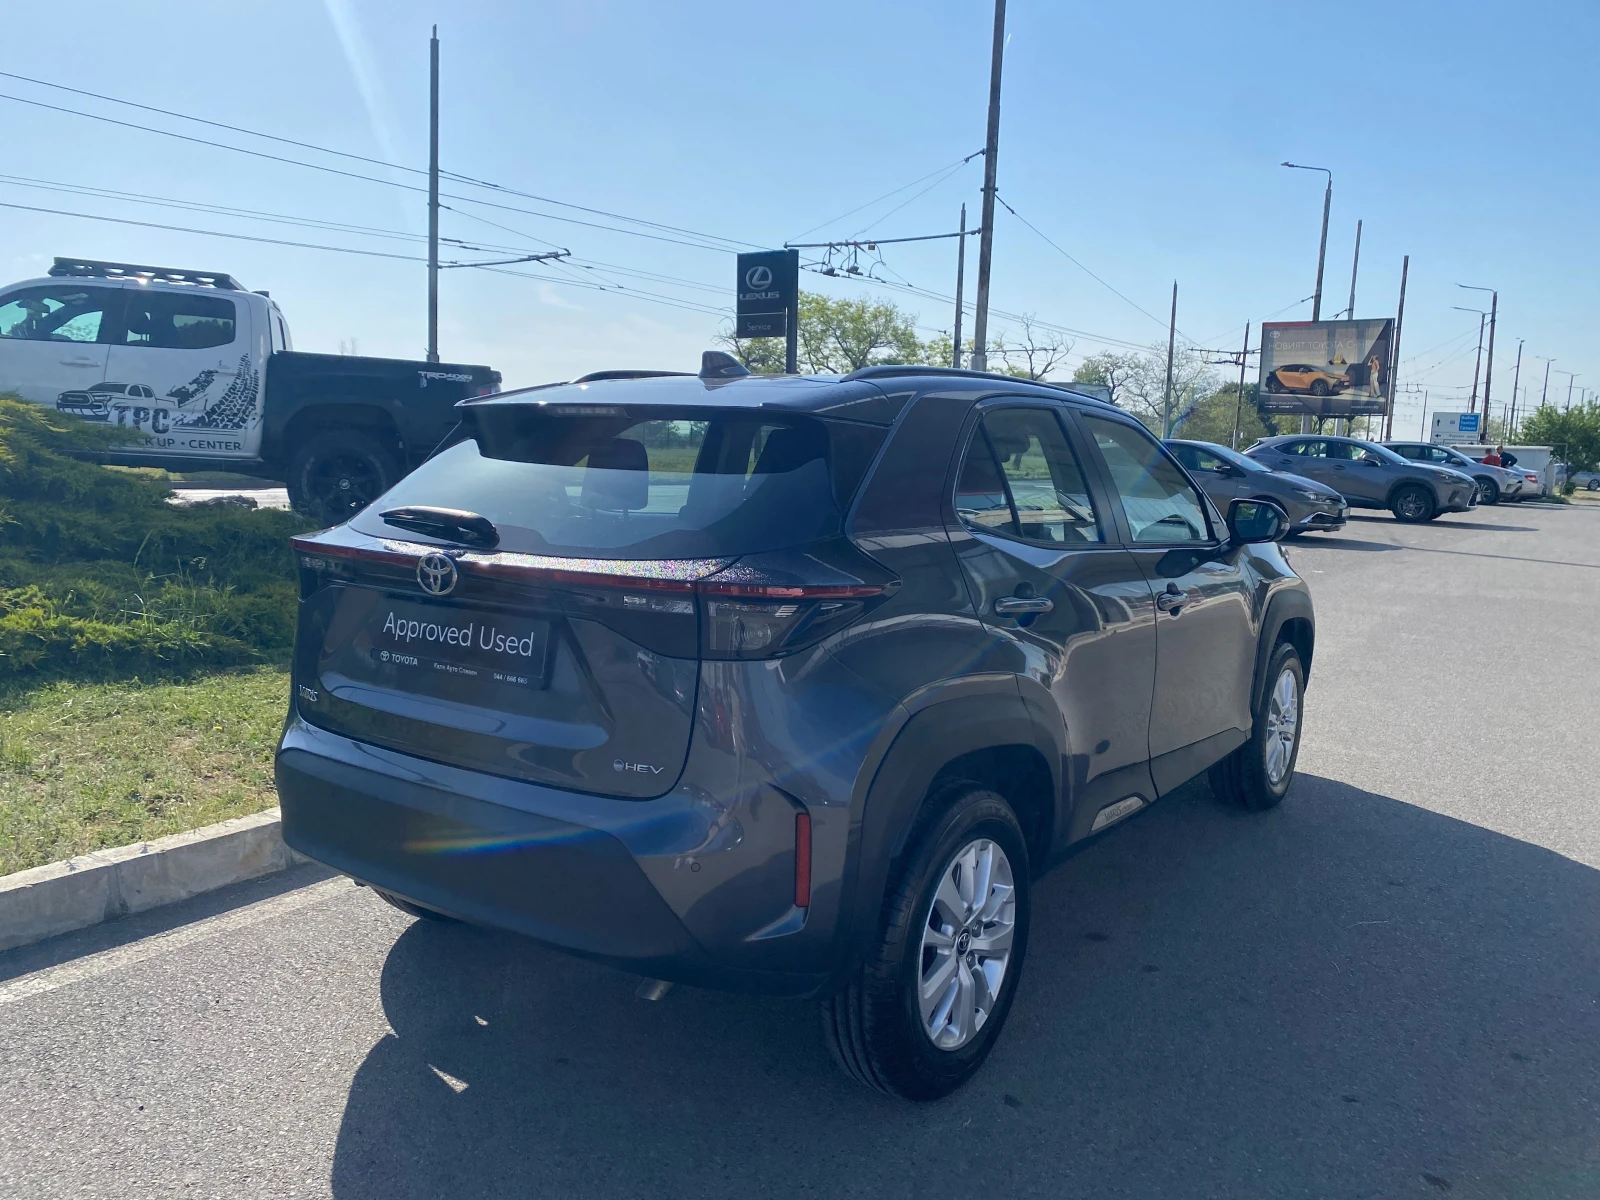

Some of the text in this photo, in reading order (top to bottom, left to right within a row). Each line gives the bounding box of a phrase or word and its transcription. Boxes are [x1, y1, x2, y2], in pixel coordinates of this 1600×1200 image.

[739, 291, 780, 300] LEXUS
[747, 321, 772, 331] Service
[1268, 341, 1306, 351] НОВИЯТ
[1308, 340, 1343, 350] TOYOTA
[113, 406, 169, 434] TPC
[188, 439, 242, 451] CENTER
[382, 611, 534, 657] Approved Used
[391, 653, 418, 666] TOYOTA
[625, 762, 665, 775] HEV
